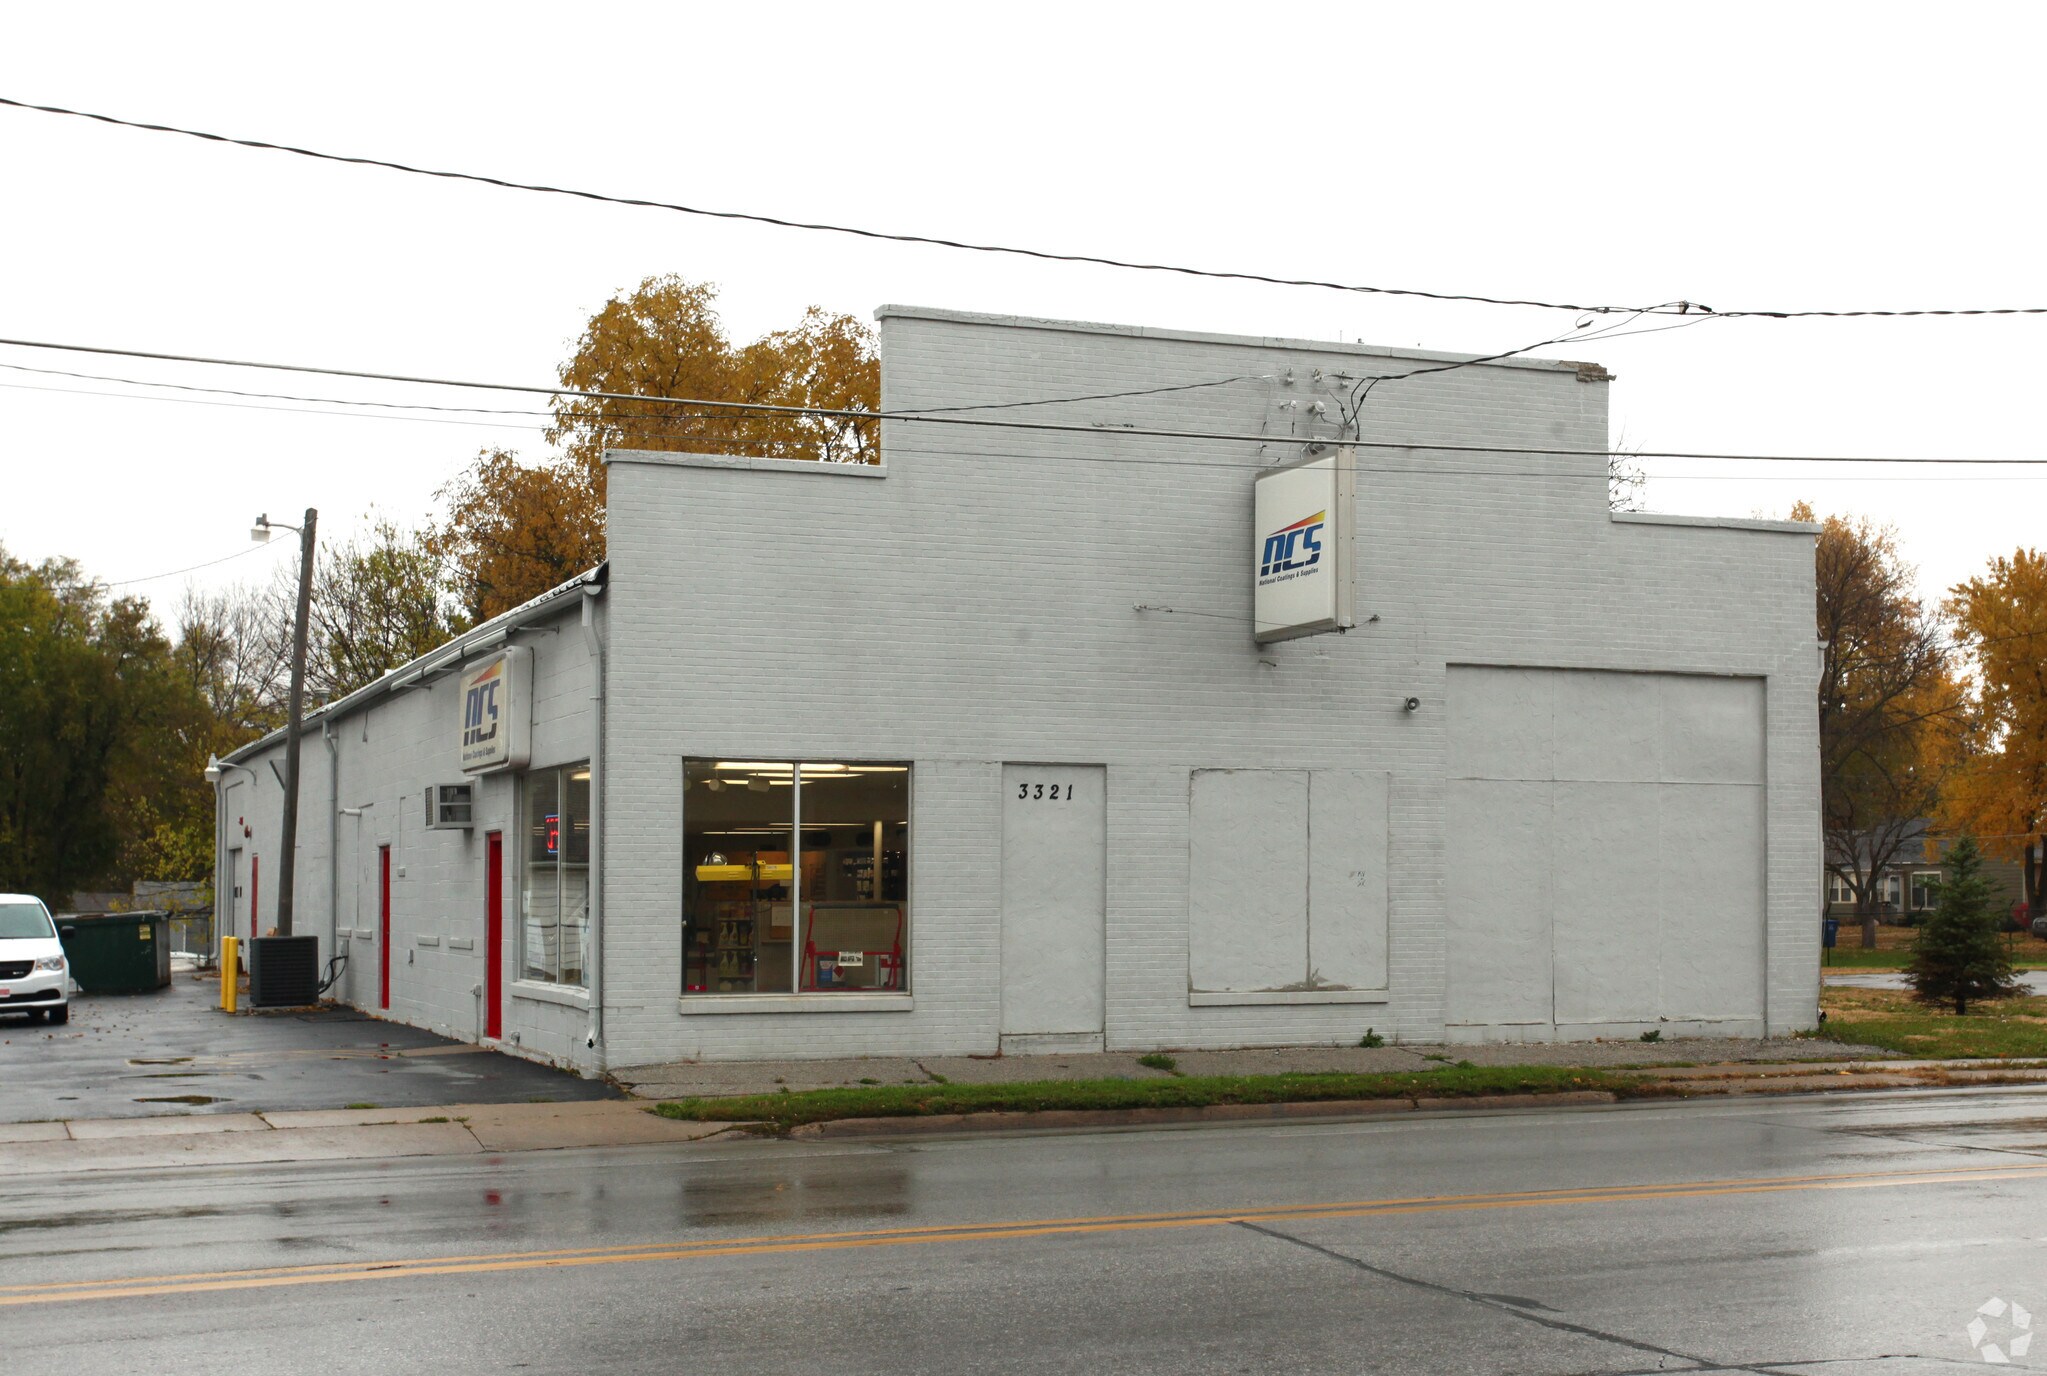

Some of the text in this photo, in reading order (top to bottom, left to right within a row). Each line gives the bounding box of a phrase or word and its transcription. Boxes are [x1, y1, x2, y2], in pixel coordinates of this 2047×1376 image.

[1259, 576, 1276, 586] National
[1277, 573, 1295, 582] Coatings
[1300, 567, 1319, 577] Supplies
[1018, 783, 1073, 800] 3321
